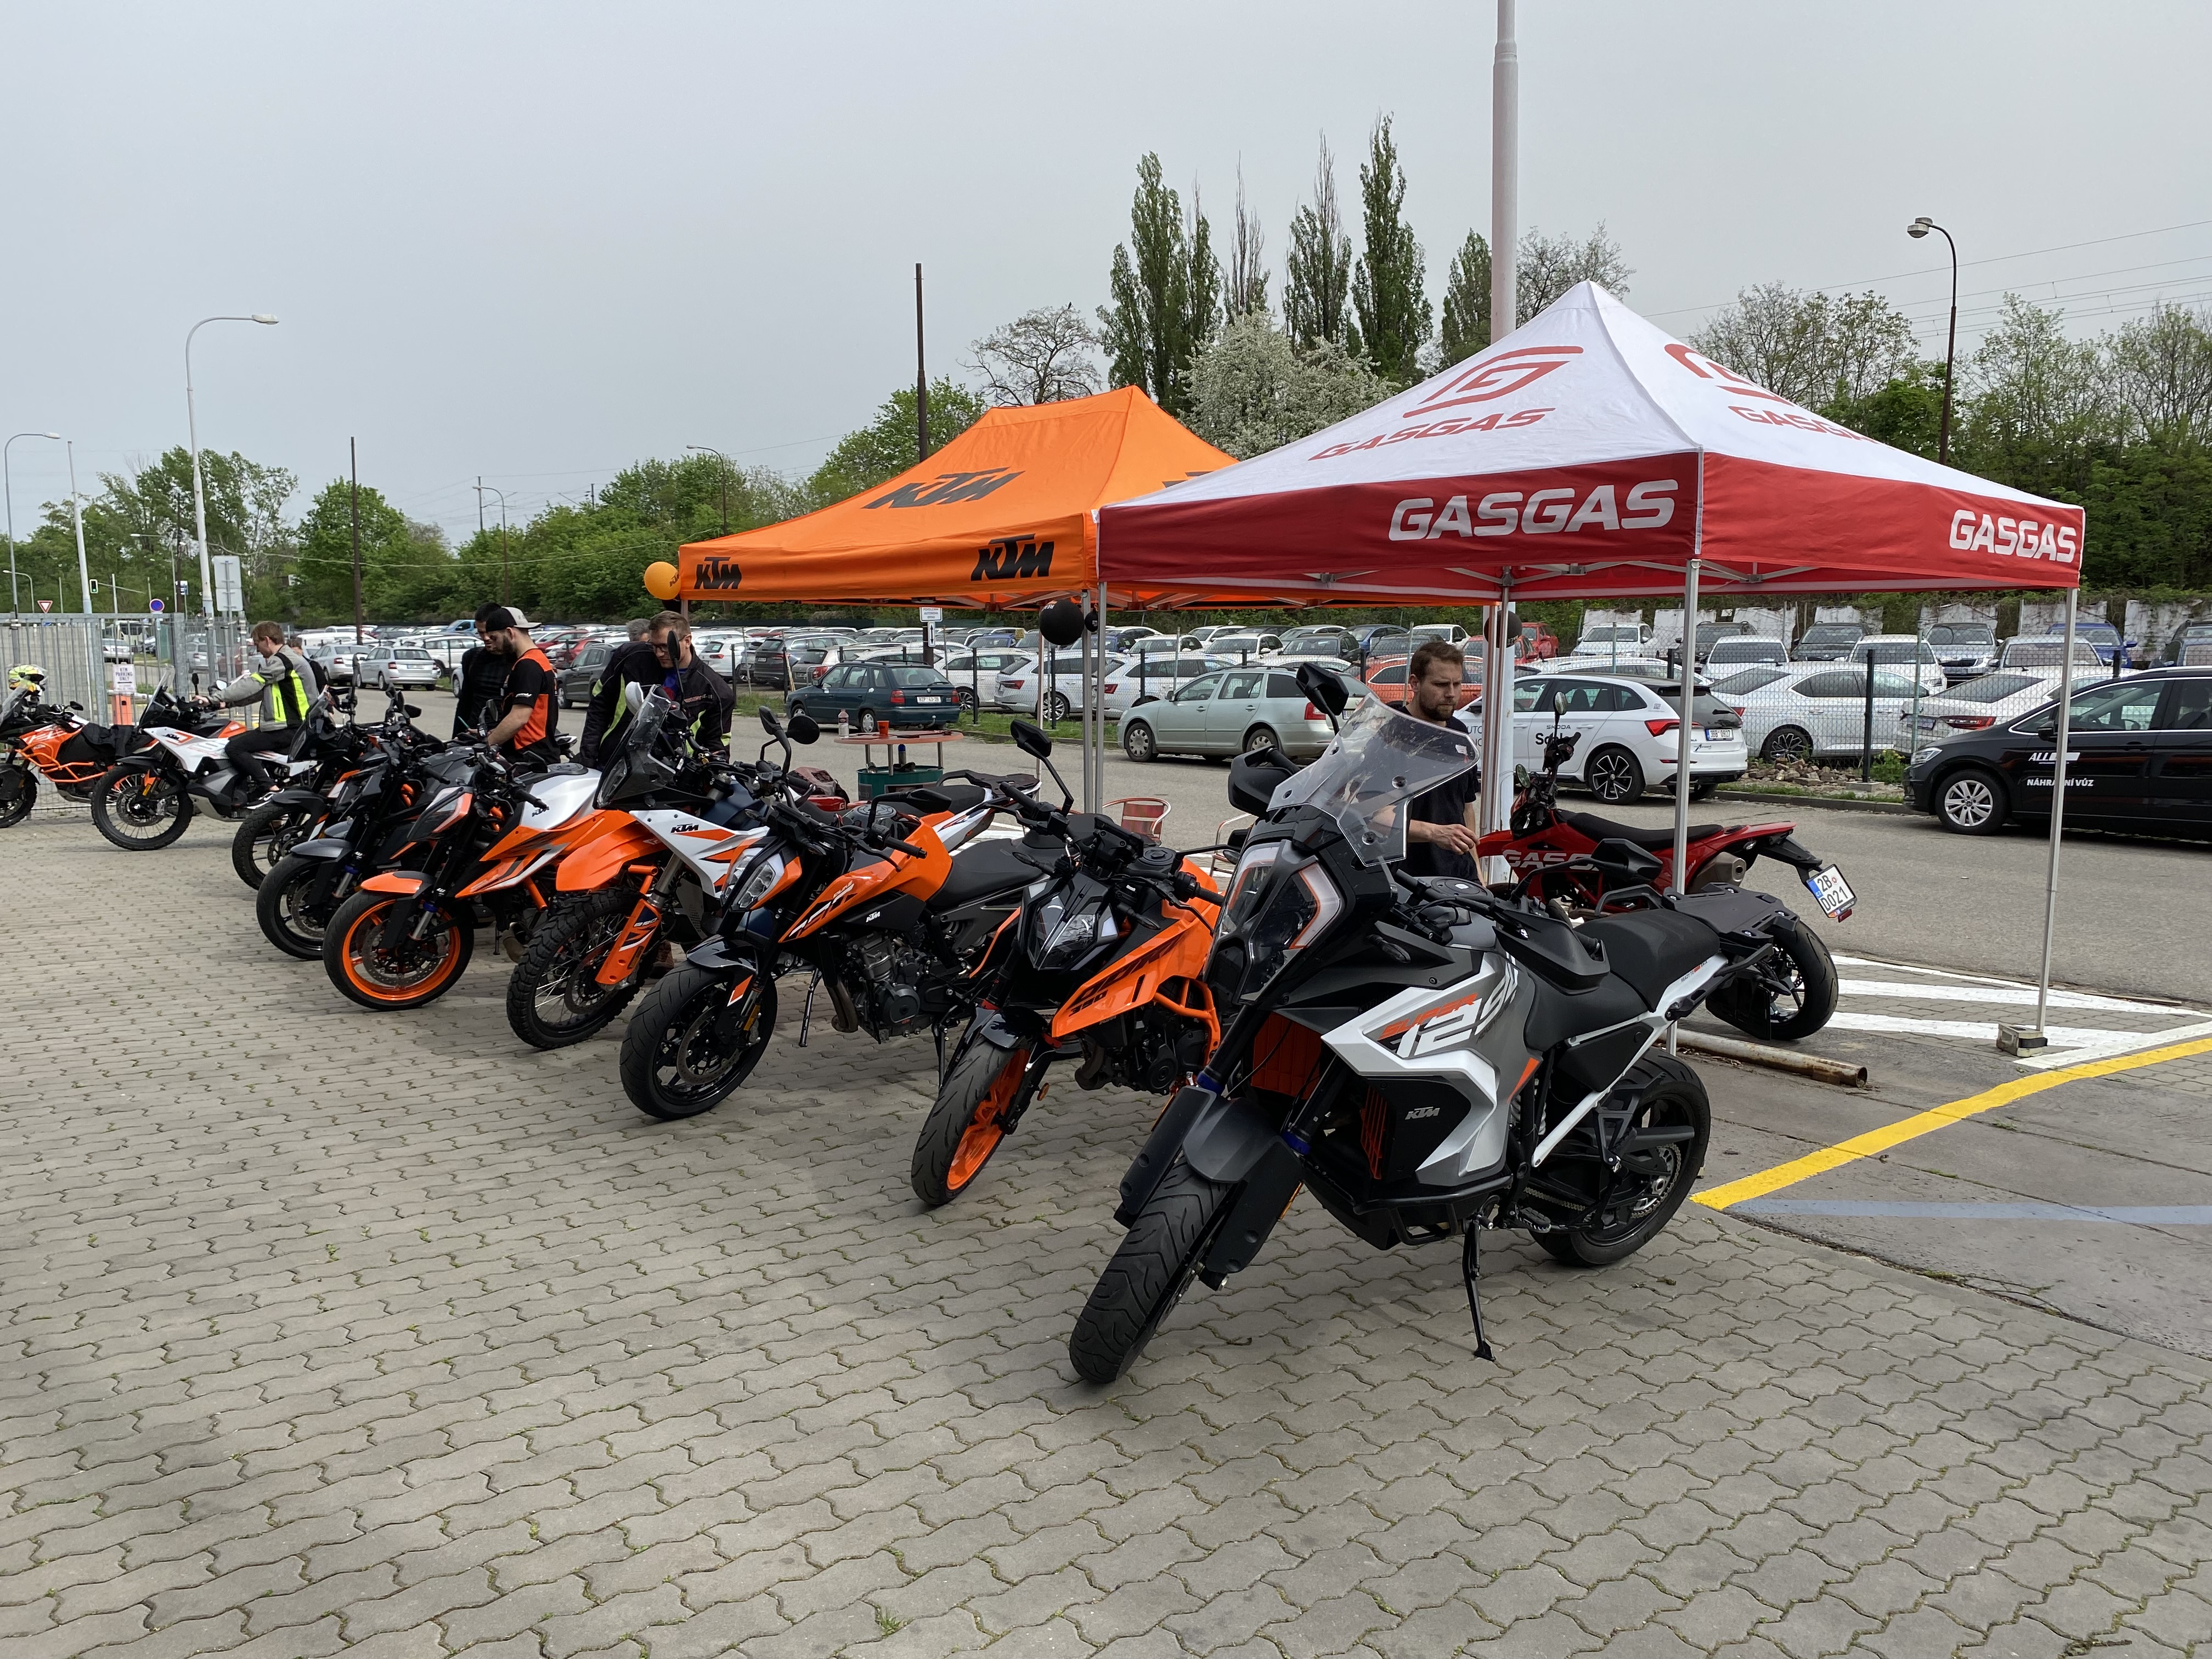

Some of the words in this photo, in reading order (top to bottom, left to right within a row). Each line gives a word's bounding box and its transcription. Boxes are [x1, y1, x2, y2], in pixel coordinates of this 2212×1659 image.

[1308, 408, 1556, 461] GASGAS
[860, 466, 1026, 509] KTM
[1389, 479, 1678, 541] GASGAS
[1949, 509, 2076, 563] GASGAS
[970, 533, 1054, 582] KTM
[693, 557, 742, 589] KTM
[2075, 778, 2094, 786] VŮZ
[670, 823, 699, 833] KTM
[1817, 874, 1832, 892] 2B
[1820, 886, 1848, 911] D021
[866, 911, 881, 923] KTM
[1069, 989, 1108, 1017] 390
[1378, 992, 1479, 1040] SUPER
[1404, 1106, 1440, 1120] KTM
